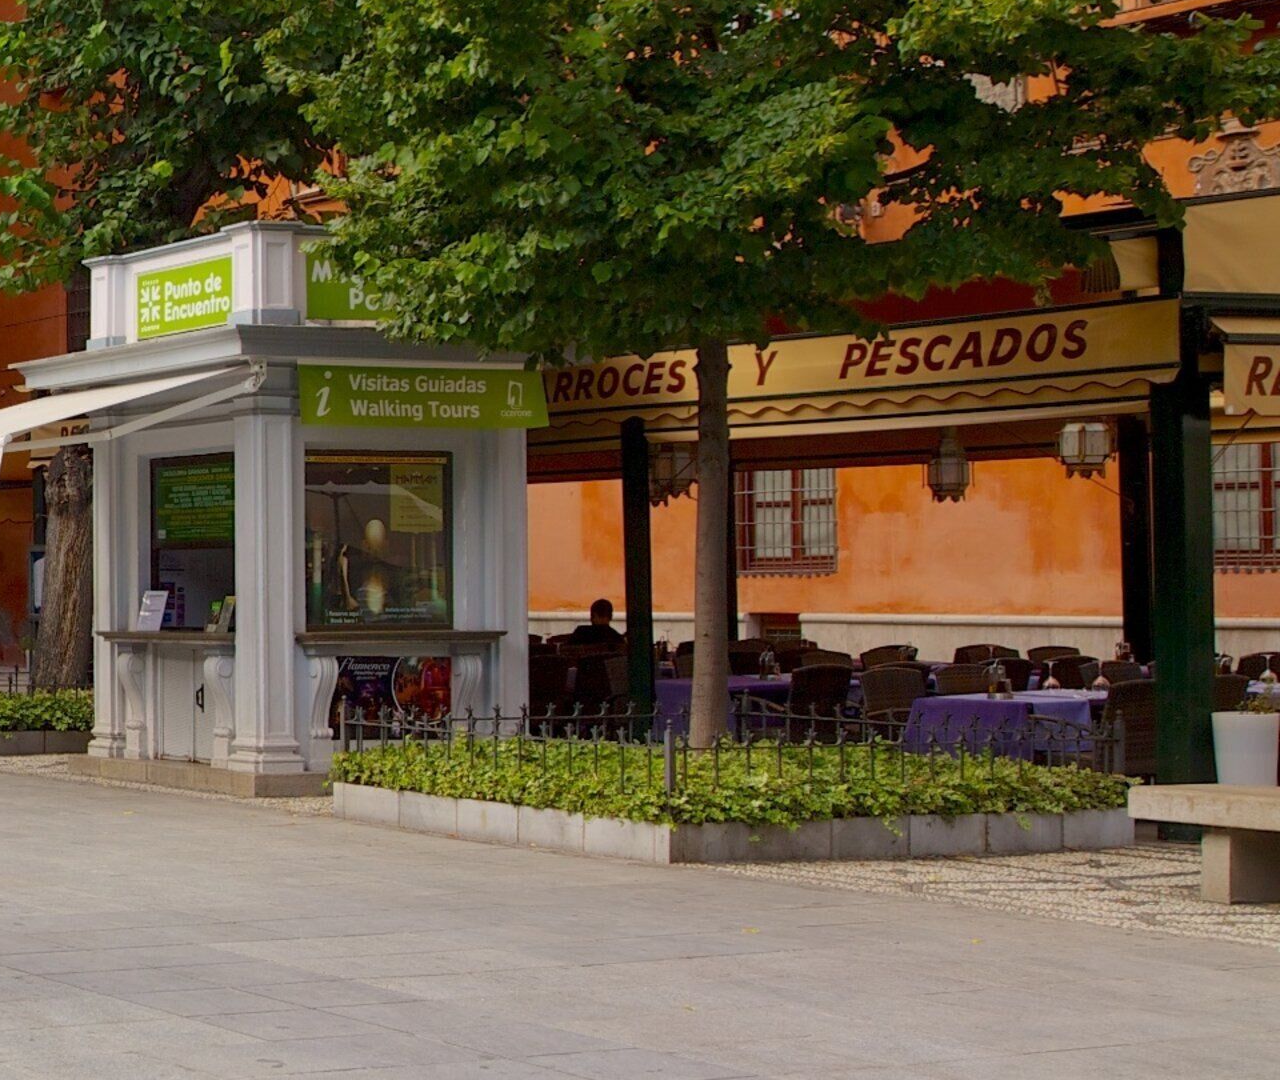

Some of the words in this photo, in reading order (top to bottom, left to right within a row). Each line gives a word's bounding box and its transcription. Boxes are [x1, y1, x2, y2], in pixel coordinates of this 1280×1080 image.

[164, 278, 201, 301] Punto
[204, 272, 222, 294] de
[164, 294, 230, 322] Encuentro
[552, 359, 687, 403] RROCES
[754, 350, 779, 386] Y
[839, 320, 1089, 379] PESCADOS
[348, 374, 410, 393] Visitas
[415, 375, 487, 394] Guiadas
[349, 399, 424, 421] Walking
[428, 401, 481, 419] Tours
